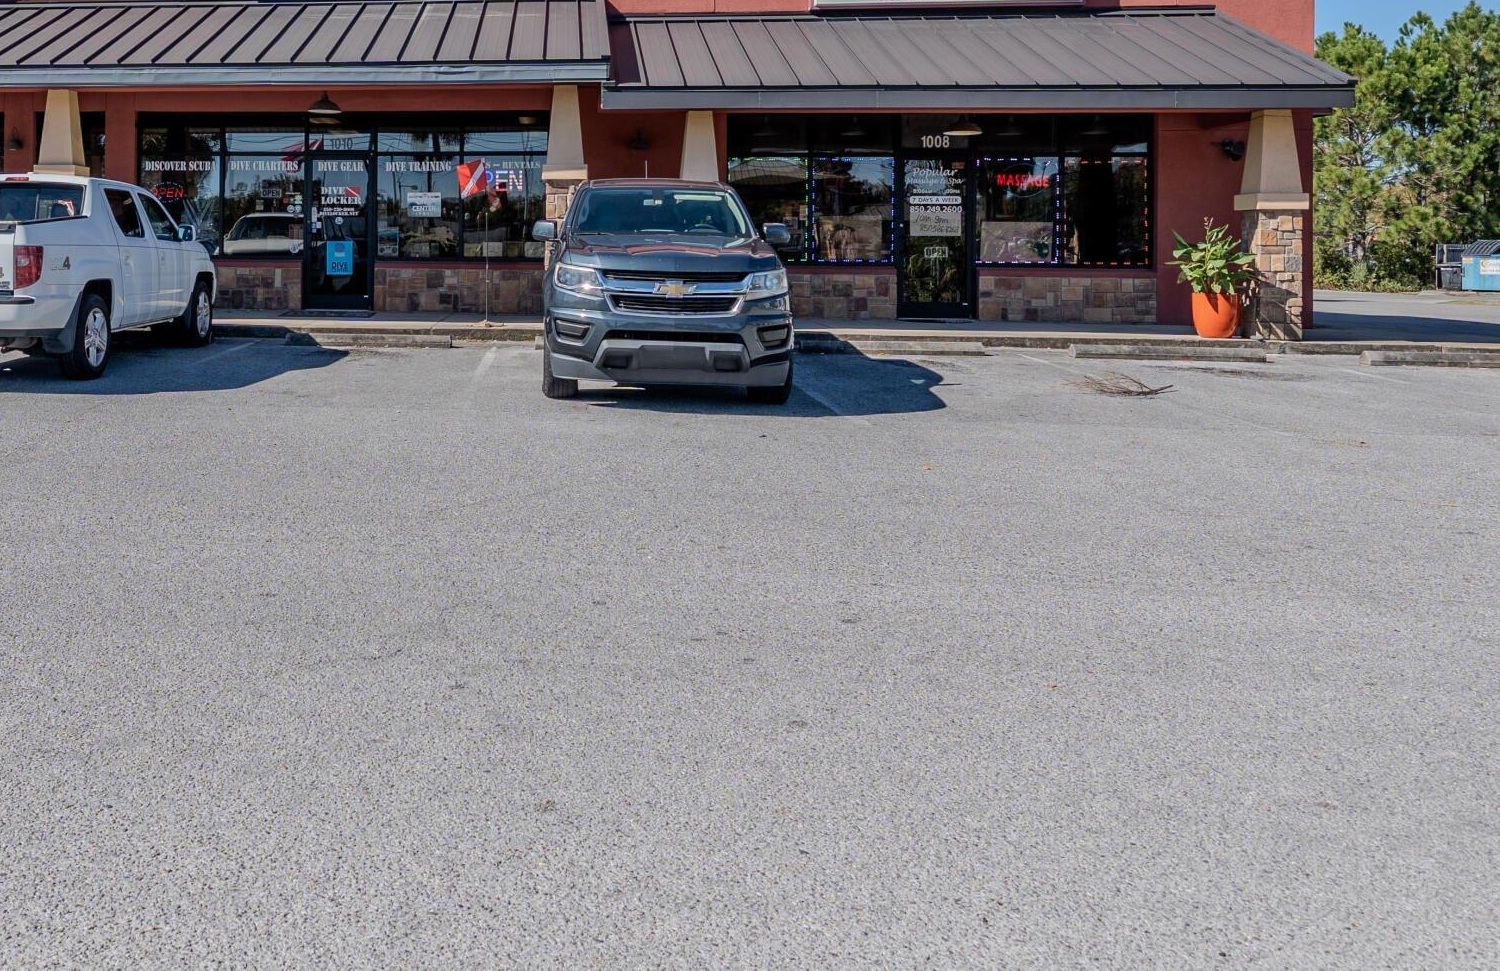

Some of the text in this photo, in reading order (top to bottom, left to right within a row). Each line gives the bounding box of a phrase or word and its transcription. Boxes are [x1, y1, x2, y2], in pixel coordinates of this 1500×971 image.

[330, 138, 353, 150] 1010
[920, 135, 950, 148] 1008
[145, 160, 217, 171] DISCOVER SCUBA
[230, 160, 299, 171] DIVE CHARTERS
[318, 161, 364, 172] DIVE GEAR
[385, 161, 452, 172] DIVE TRAINING
[502, 161, 541, 169] RENTALS
[912, 166, 958, 178] Popular
[948, 177, 964, 188] Spa
[996, 174, 1050, 186] MASSAGE
[262, 189, 280, 197] OPEN
[321, 186, 345, 195] DIVE
[321, 196, 362, 205] LOCKER
[331, 261, 349, 269] DIVE
